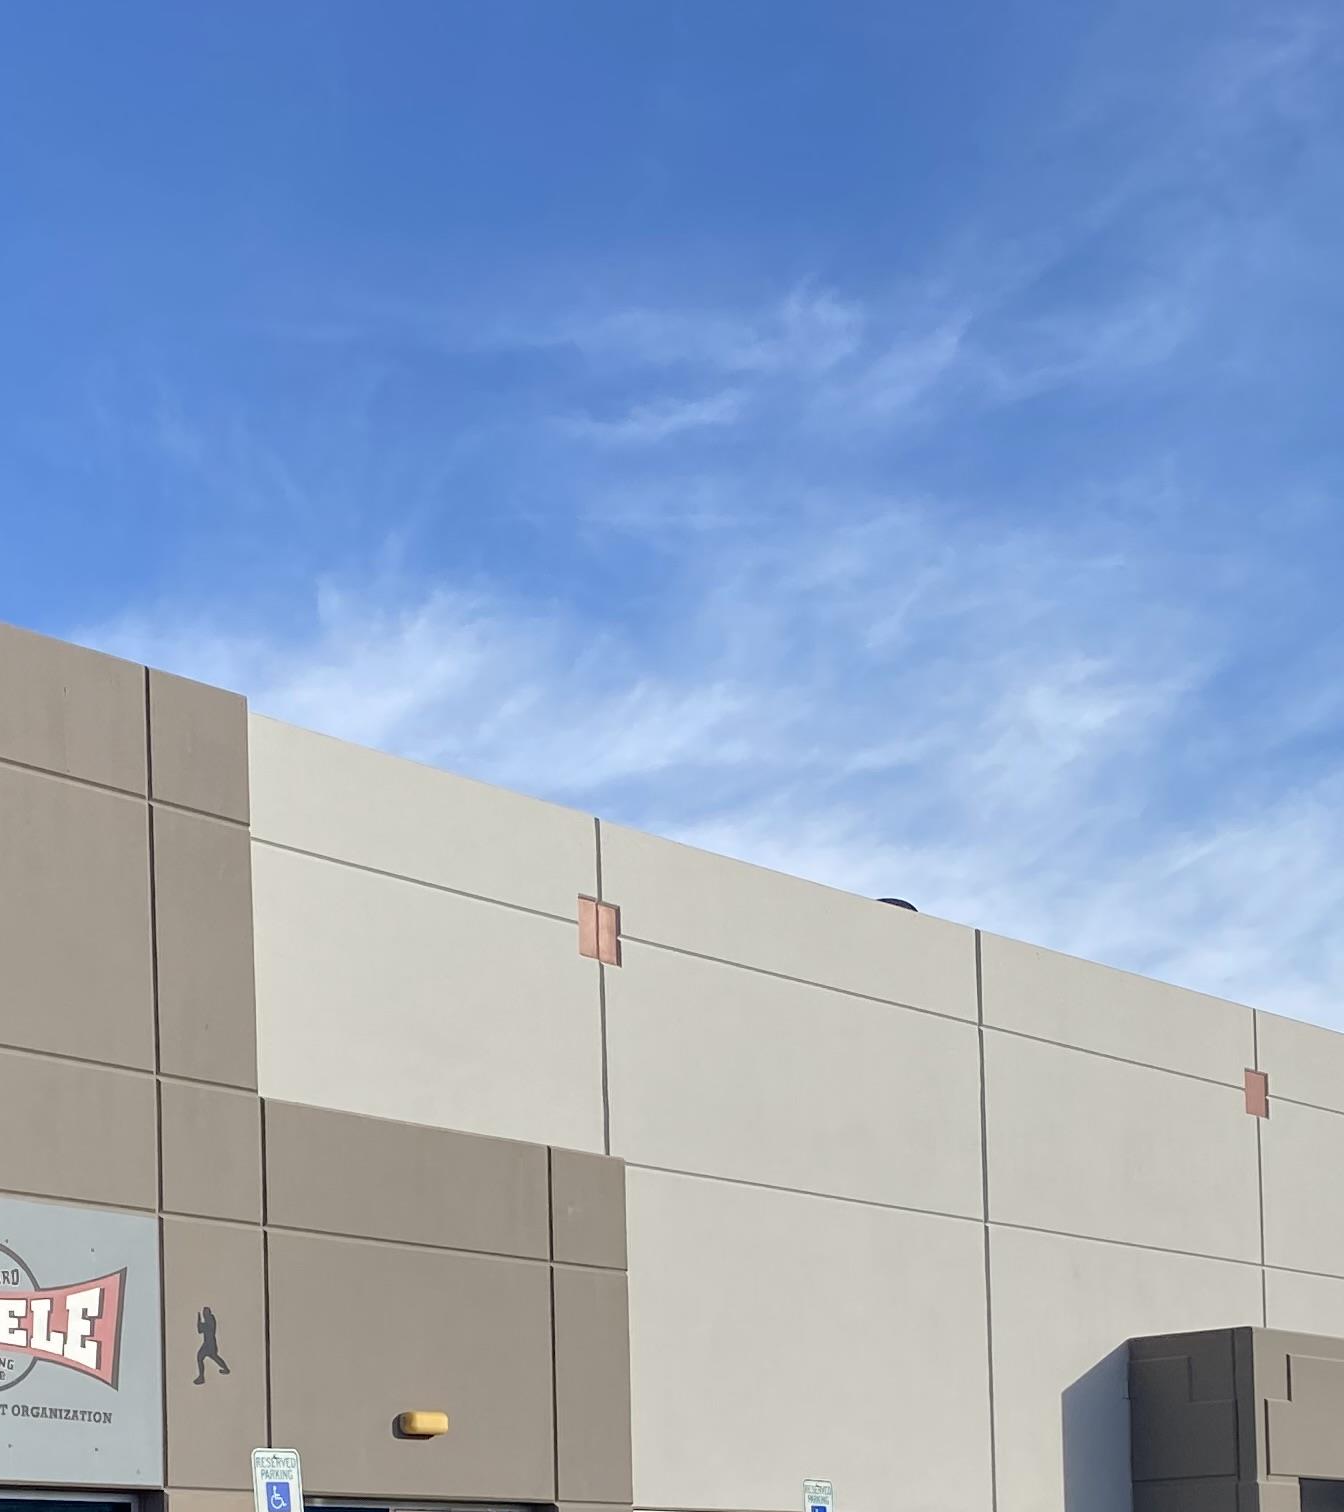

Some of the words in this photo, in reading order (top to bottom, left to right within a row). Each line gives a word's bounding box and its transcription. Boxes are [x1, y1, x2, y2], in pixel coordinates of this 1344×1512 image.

[11, 1404, 113, 1424] ORGANIZATION
[255, 1456, 296, 1468] RESERVED
[261, 1469, 294, 1480] PARKING
